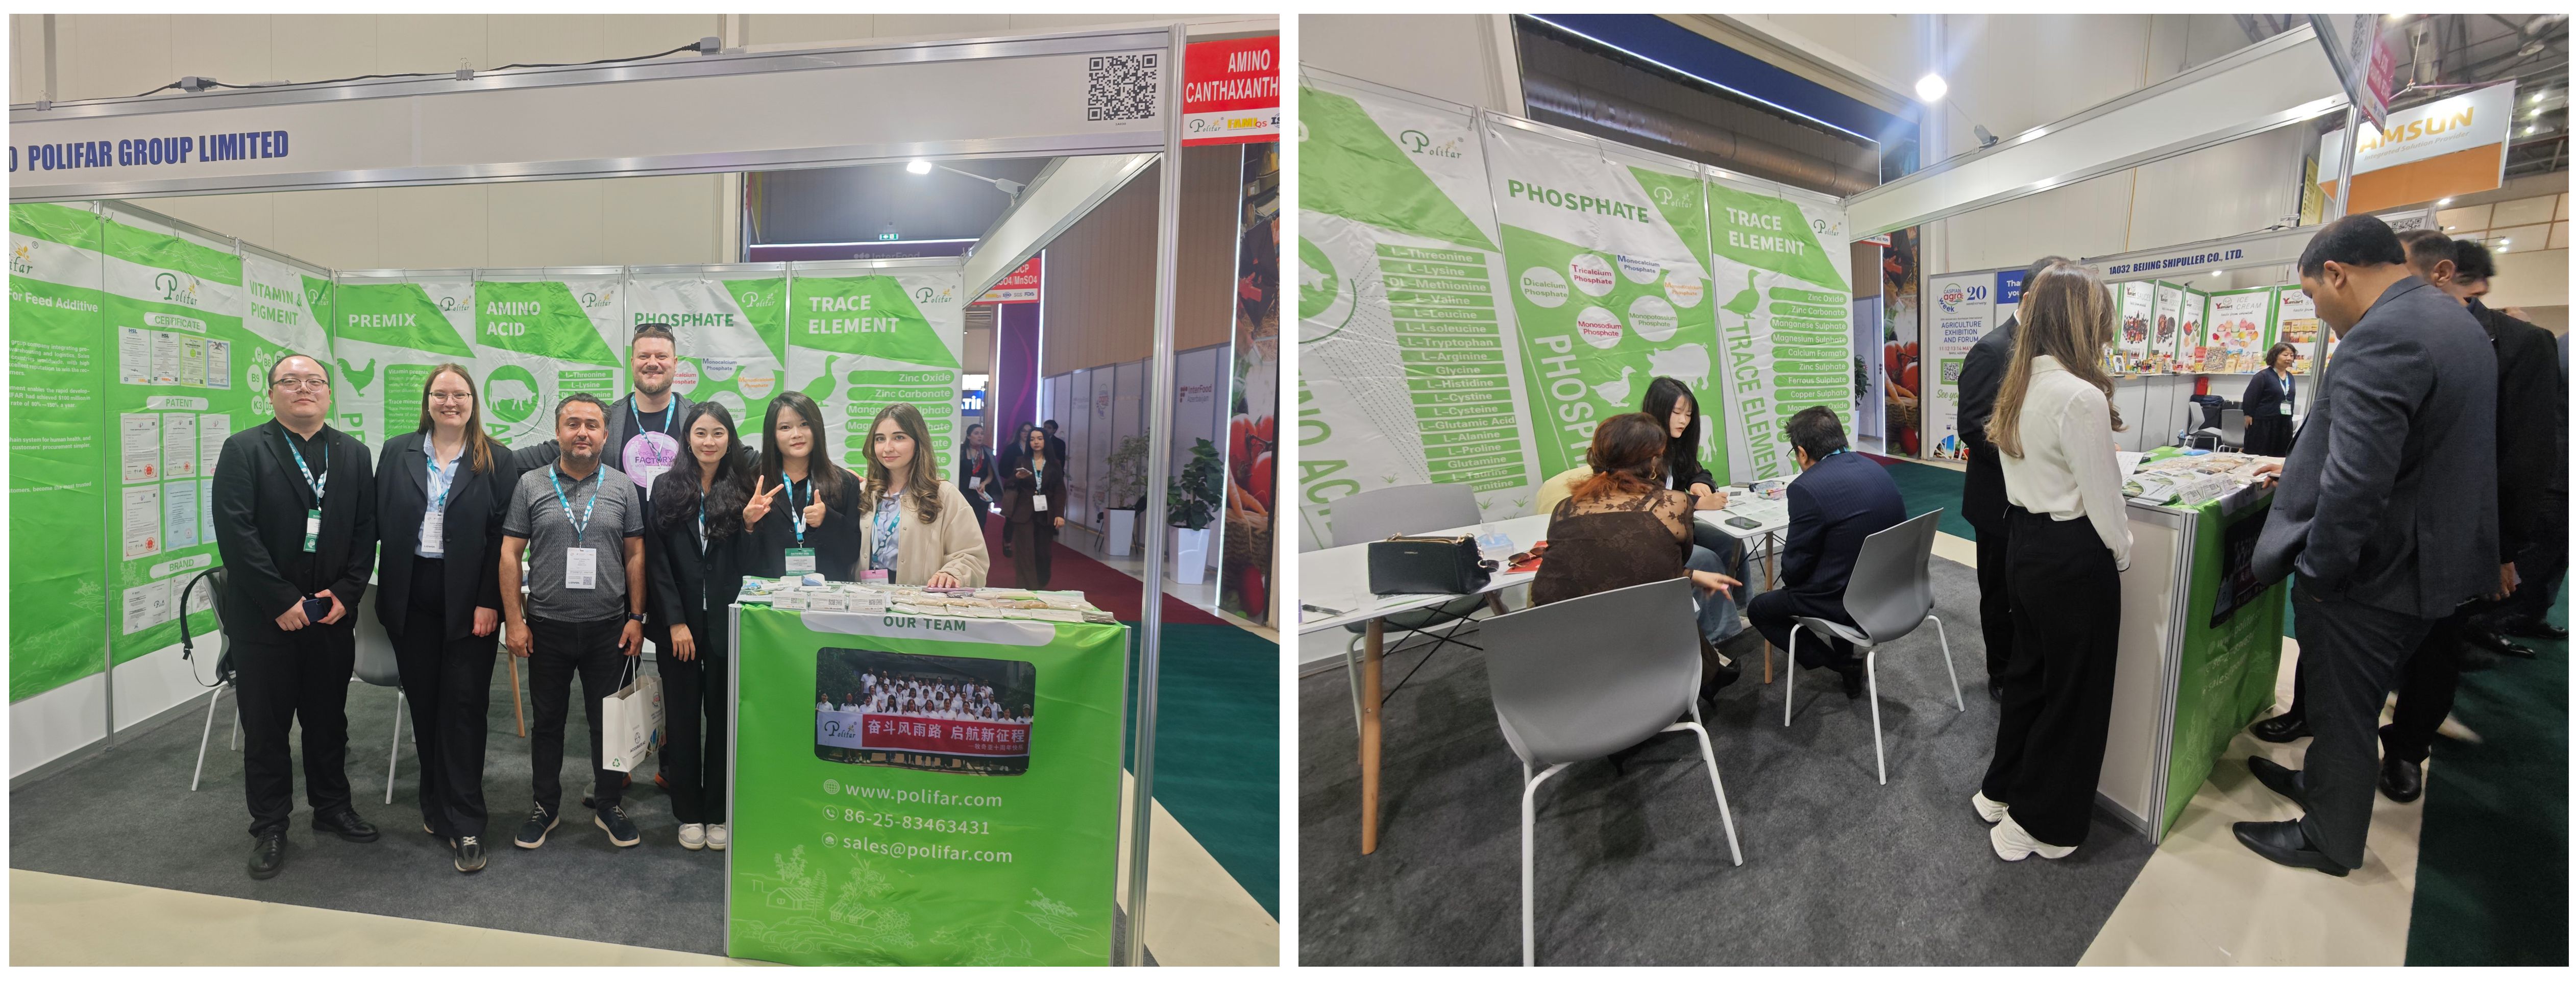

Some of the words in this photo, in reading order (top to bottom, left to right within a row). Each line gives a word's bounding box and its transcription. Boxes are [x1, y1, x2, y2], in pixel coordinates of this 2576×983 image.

[1227, 48, 1270, 73] AMINO
[1186, 77, 1280, 103] CANTHAXANTH
[1189, 118, 1221, 133] Polifar
[2359, 107, 2474, 153] AMSUN
[29, 141, 112, 171] POLIFAR
[118, 136, 193, 166] GROUP
[199, 131, 289, 162] LIMITED
[1400, 130, 1462, 159] Polifar
[2364, 146, 2400, 161] Integrated
[2401, 140, 2434, 152] Solution
[2435, 131, 2470, 144] Provider
[1508, 179, 1650, 224] PHOSPHATE
[1654, 186, 1693, 209] Polifar
[1726, 207, 1782, 231] TRACE
[1813, 219, 1839, 236] Polifar
[1729, 231, 1805, 256] ELEMENT
[1391, 247, 1473, 262] L-Threonine
[1617, 255, 1660, 267] Monocalcium
[1624, 264, 1656, 274] Phosphate
[2109, 264, 2130, 275] 1A032
[2133, 260, 2161, 272] BEIJING
[2163, 255, 2205, 268] SHIPULLER
[2207, 252, 2223, 263] CO.,
[2225, 249, 2244, 260] LTD.
[1408, 264, 1465, 276] L-Lysine
[1572, 264, 1612, 276] Tricalcium
[1389, 277, 1486, 292] DL-Methionine
[1524, 277, 1566, 289] Dicalcium
[1574, 275, 1612, 285] Phosphate
[155, 272, 199, 306] Polifar
[250, 279, 293, 305] VITAMIN
[296, 293, 302, 307] &
[916, 287, 952, 304] Polifar
[1525, 288, 1568, 298] Phosphate
[1967, 285, 1986, 301] 20
[9, 288, 22, 303] For
[25, 292, 52, 308] Feed
[55, 296, 99, 313] Additive
[582, 292, 611, 308] Polifar
[742, 291, 775, 307] Polifar
[809, 295, 871, 312] TRACE
[1415, 294, 1470, 305] L-Valine
[1944, 292, 1962, 302] agro
[440, 297, 470, 312] Polifar
[486, 301, 541, 316] AMINO
[1792, 306, 1806, 314] Zinc
[1808, 307, 1845, 315] Carbonate
[1939, 298, 1954, 312] week
[251, 302, 298, 326] PIGMENT
[634, 312, 734, 327] PHOSPHATE
[1414, 308, 1477, 318] L-Leucine
[1629, 312, 1677, 321] Monopotassium
[155, 315, 201, 330] CERTIFICATE
[349, 313, 416, 328] PREMIX
[808, 317, 900, 334] ELEMENT
[1578, 321, 1622, 330] Monosodium
[1772, 319, 1813, 329] Manganese
[486, 322, 525, 336] ACID
[1406, 323, 1486, 333] L-Lsoleucine
[1583, 329, 1619, 337] Phosphate
[1408, 337, 1493, 348] L-Tryptophan
[1773, 334, 1813, 342] Magnesium
[257, 350, 261, 359] H
[1421, 352, 1487, 362] L-Arginine
[1726, 321, 1762, 394] TRACE
[264, 358, 271, 367] B6
[1436, 365, 1481, 375] Glycine
[251, 374, 260, 383] B9
[899, 374, 919, 382] Zinc
[922, 374, 950, 382] Oxide
[1427, 379, 1493, 388] L-Histidine
[875, 389, 895, 398] Zinc
[898, 389, 950, 398] Carbonate
[1188, 384, 1212, 394] InterFood
[1936, 389, 1949, 399] See
[166, 399, 193, 408] PATENT
[1435, 392, 1492, 402] L-Cystine
[254, 401, 262, 410] K3
[1434, 406, 1498, 416] L-Cysteine
[1420, 418, 1488, 430] L-Glutamic
[1491, 416, 1515, 425] Acid
[1443, 431, 1500, 443] L-Alanine
[1742, 397, 1779, 480] ELEMEN
[1448, 444, 1502, 455] L-Proline
[1448, 456, 1507, 468] Glutamine
[1452, 469, 1508, 481] L-Taurine
[1473, 480, 1514, 491] arnitine
[169, 559, 194, 572] BRAND
[884, 616, 916, 628] OUR
[924, 618, 966, 631] TEAM
[824, 721, 856, 739] Polifar
[868, 720, 942, 739] 奋斗风雨路
[951, 725, 1025, 743] 启航新征程
[845, 784, 1002, 807] www.polifar.com
[844, 808, 989, 834] 86-25-83463431
[843, 837, 1012, 863] sales@polifar.com
